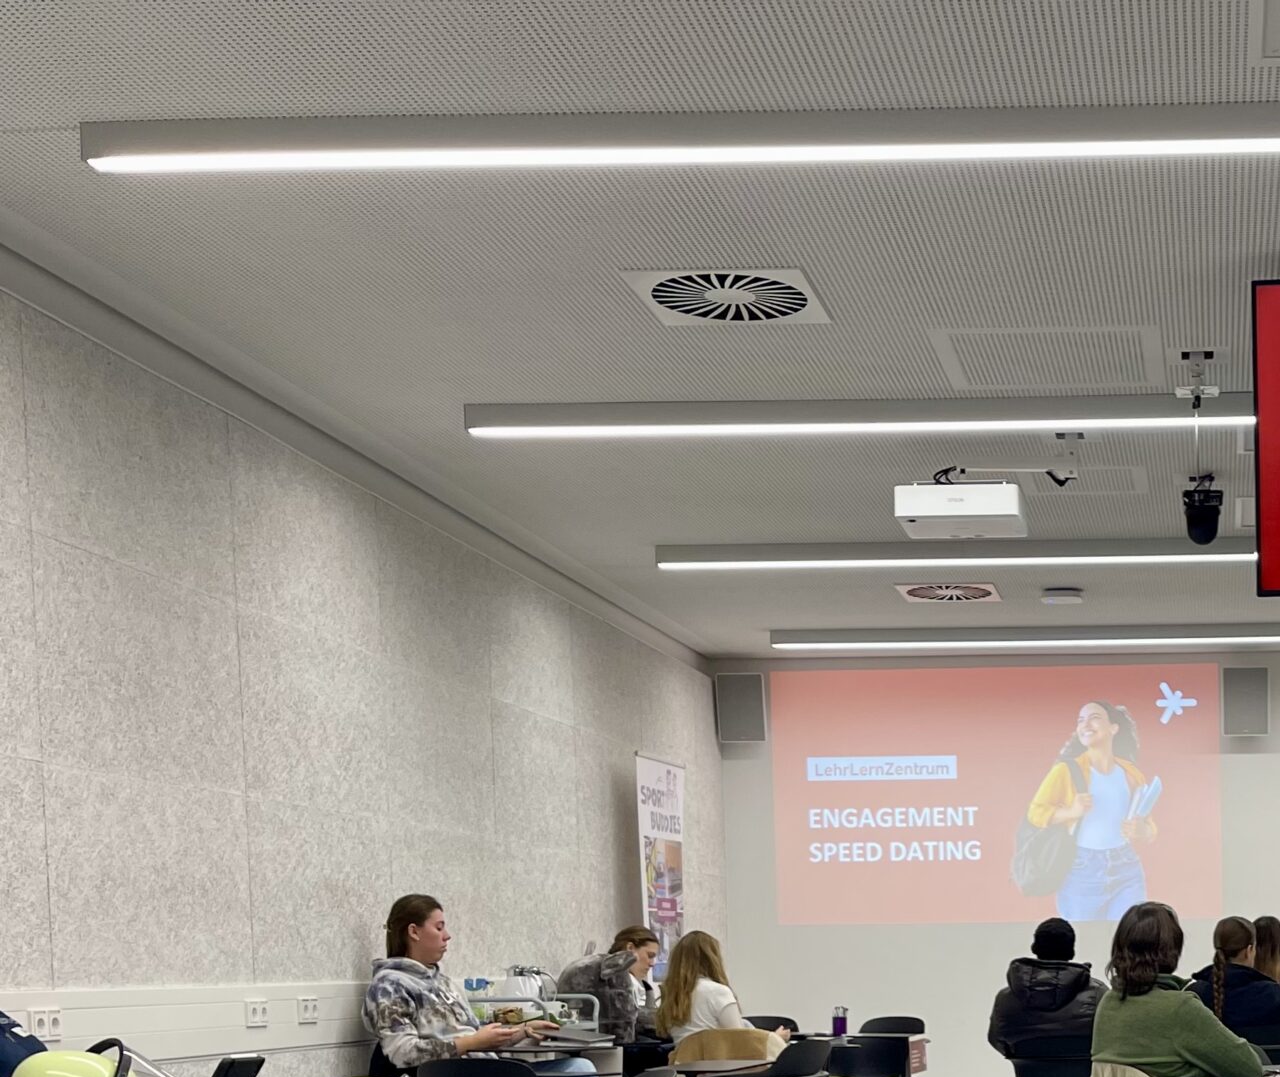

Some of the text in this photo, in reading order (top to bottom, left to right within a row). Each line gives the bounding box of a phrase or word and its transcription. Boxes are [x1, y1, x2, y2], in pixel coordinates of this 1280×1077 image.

[814, 761, 949, 777] LehrLernZentrum
[809, 806, 978, 829] ENGAGEMENT
[809, 841, 982, 863] SPEED DATING
